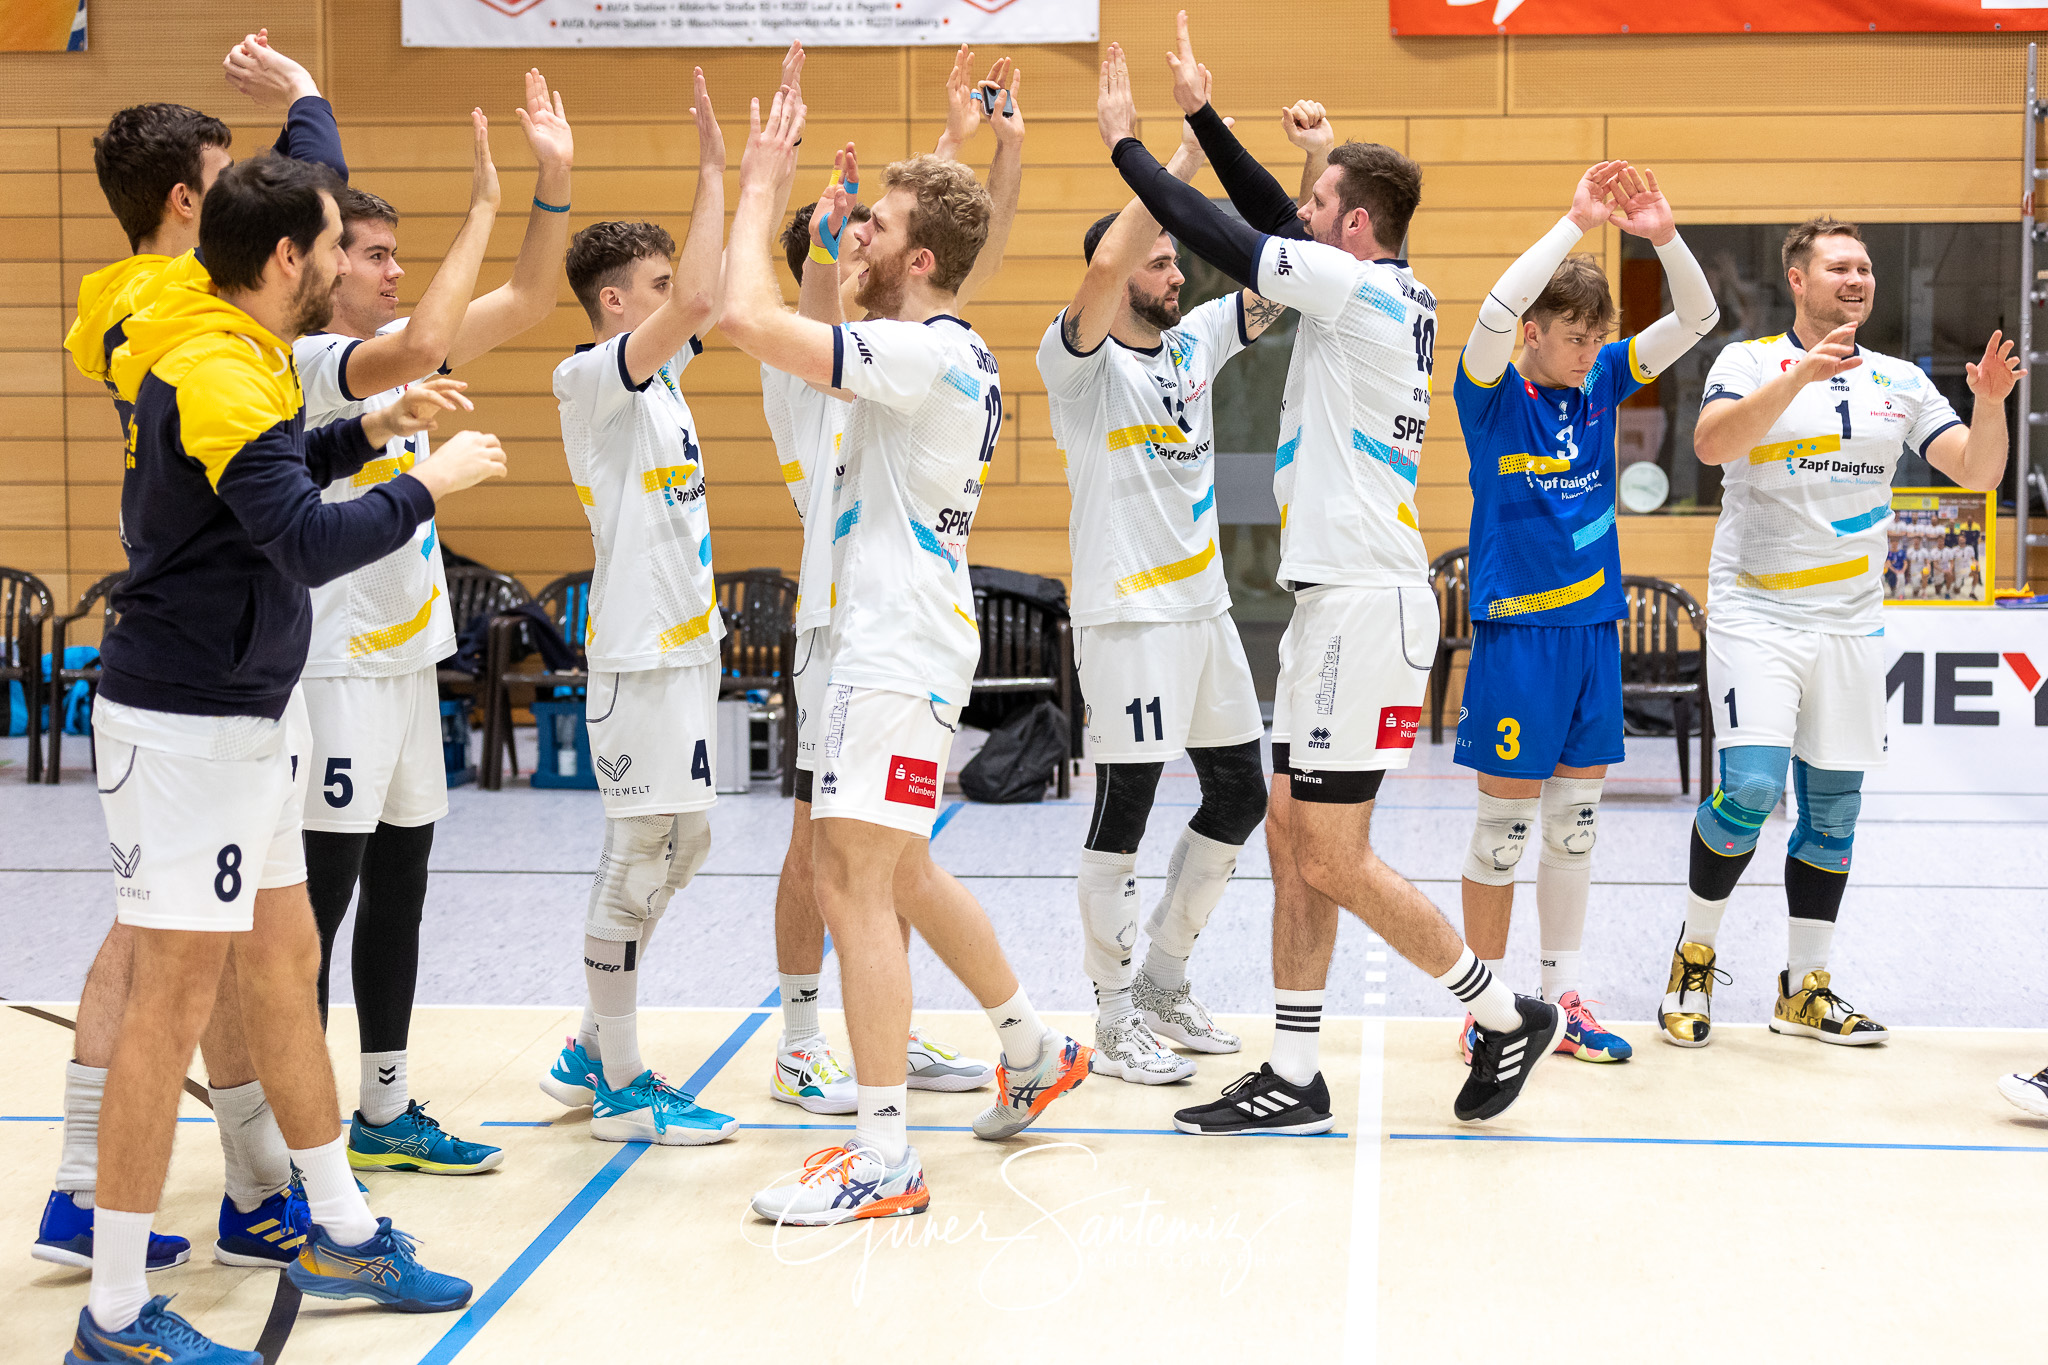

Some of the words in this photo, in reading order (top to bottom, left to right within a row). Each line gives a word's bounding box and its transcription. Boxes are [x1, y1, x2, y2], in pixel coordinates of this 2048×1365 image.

[1413, 314, 1434, 375] 10
[979, 384, 1003, 462] 12
[1835, 400, 1852, 439] 1
[1556, 425, 1580, 461] 3
[1799, 457, 1830, 473] Zapf
[1832, 460, 1886, 476] Daigfuss
[1126, 696, 1164, 742] 11
[1724, 687, 1739, 728] 1
[1308, 740, 1331, 749] errea
[1495, 717, 1521, 760] 3
[323, 757, 354, 808] 5
[690, 739, 712, 787] 4
[1294, 774, 1323, 784] erima
[1576, 818, 1595, 827] errea
[214, 843, 243, 903] 8
